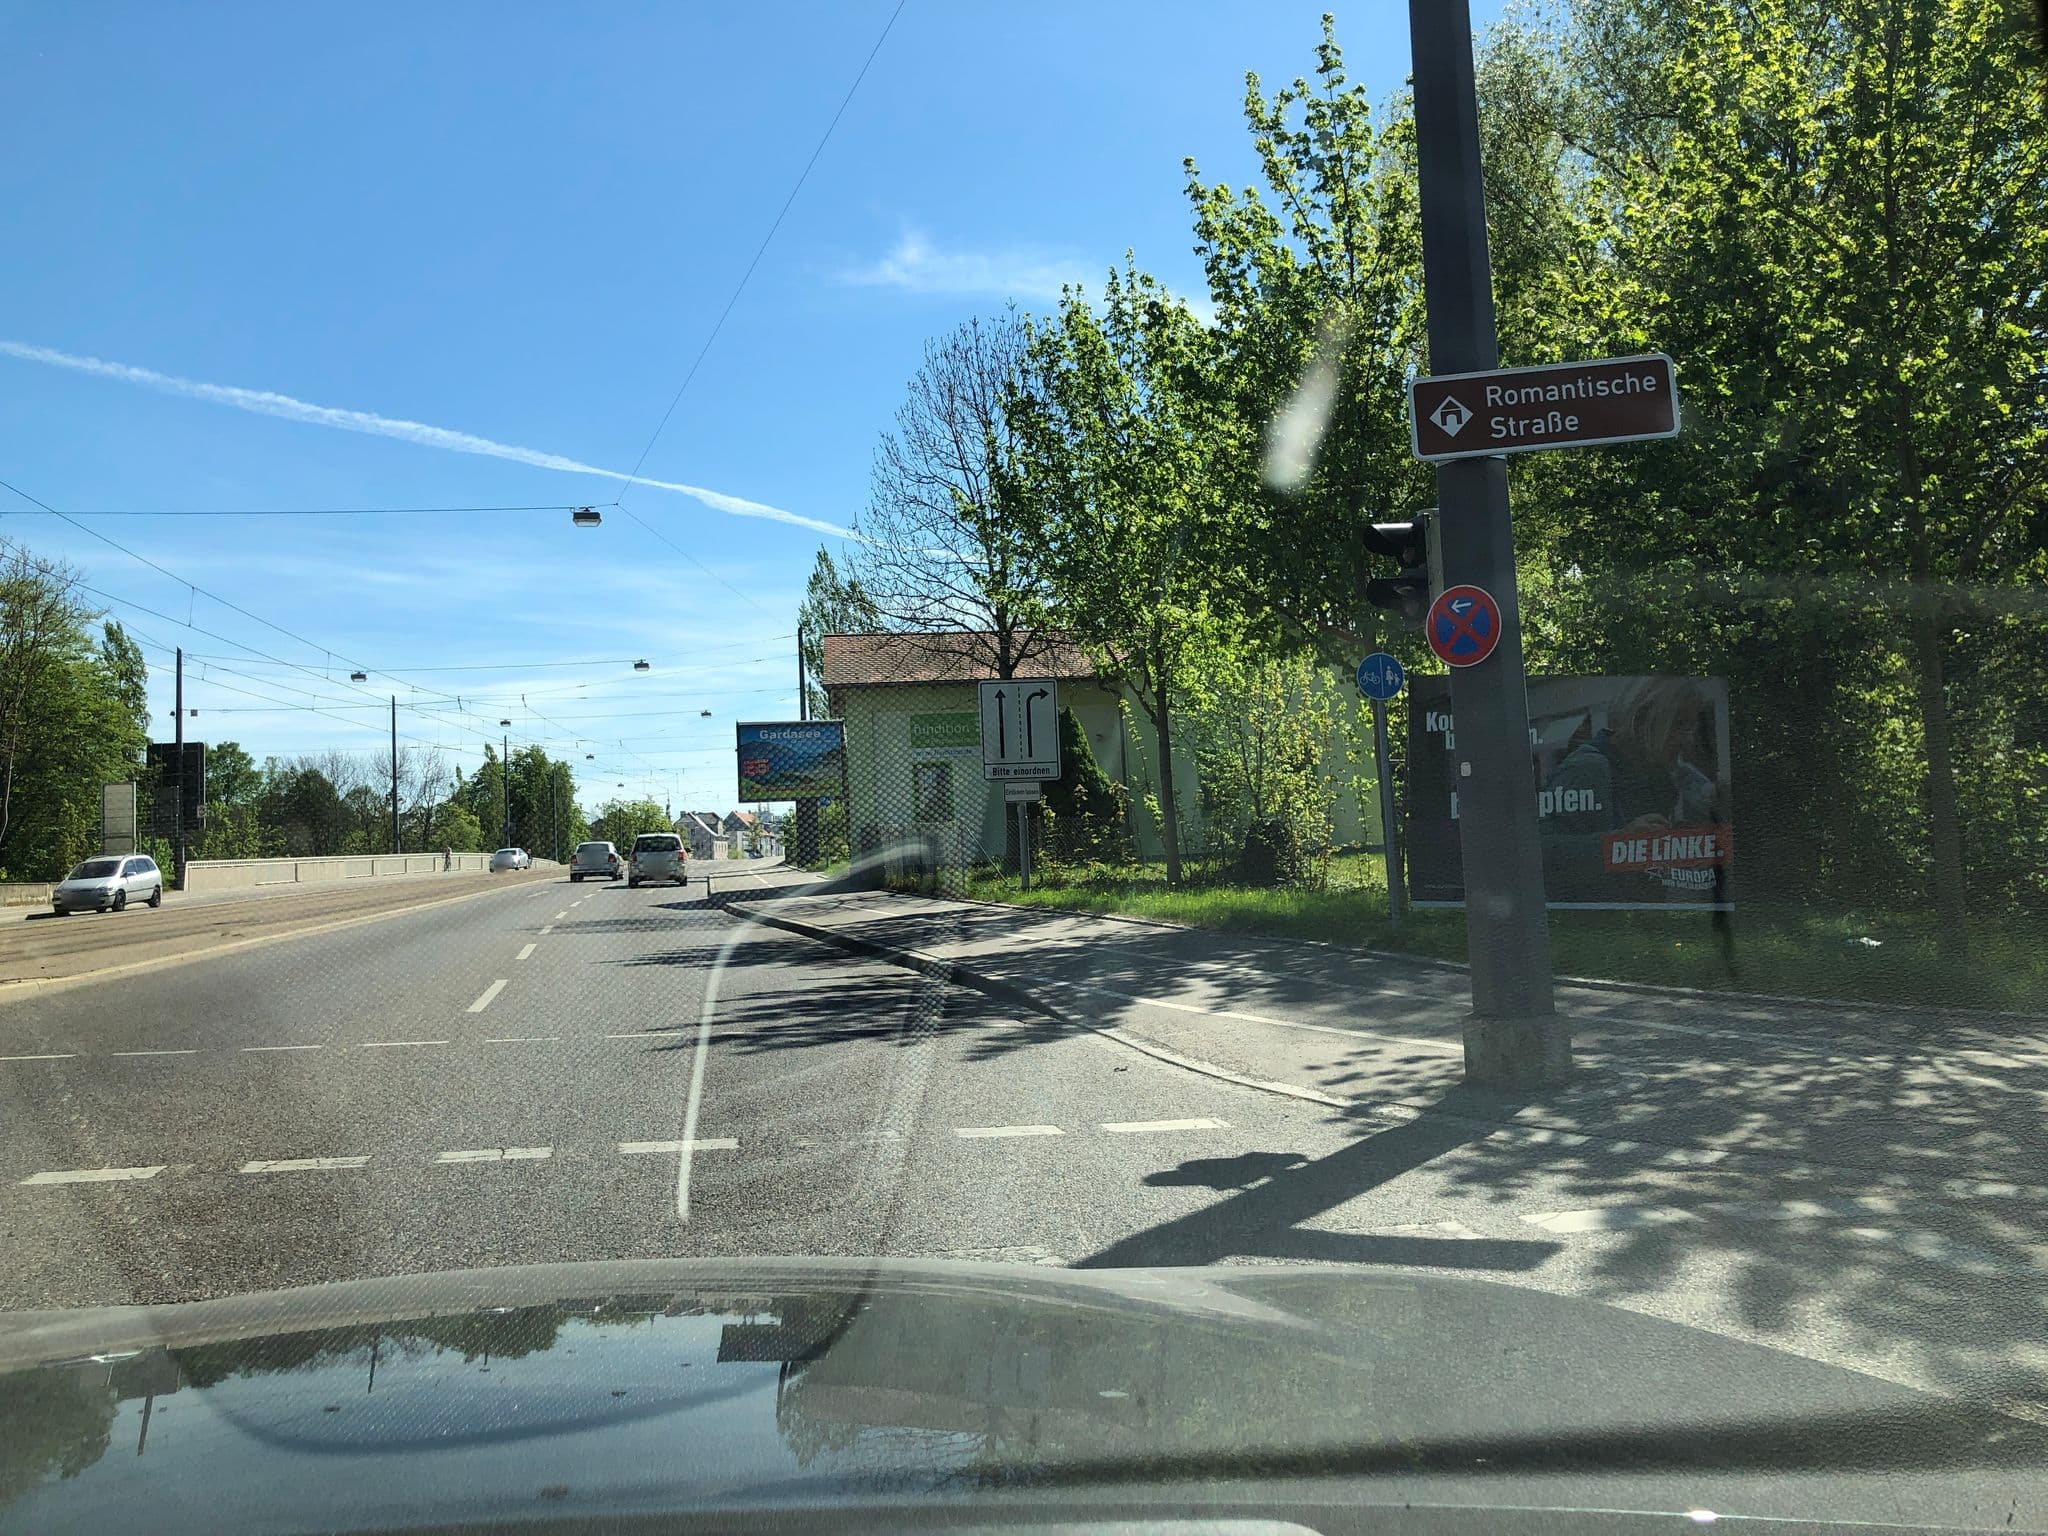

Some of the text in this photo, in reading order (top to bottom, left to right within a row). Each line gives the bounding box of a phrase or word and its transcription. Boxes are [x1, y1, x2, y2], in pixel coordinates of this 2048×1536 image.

[1485, 373, 1657, 407] Romantische
[1490, 411, 1579, 439] Straße
[760, 730, 821, 739] Gardasee
[992, 766, 1050, 776] Bitte einordnen
[1612, 839, 1648, 864] DIE
[1671, 868, 1716, 883] EUROPA
